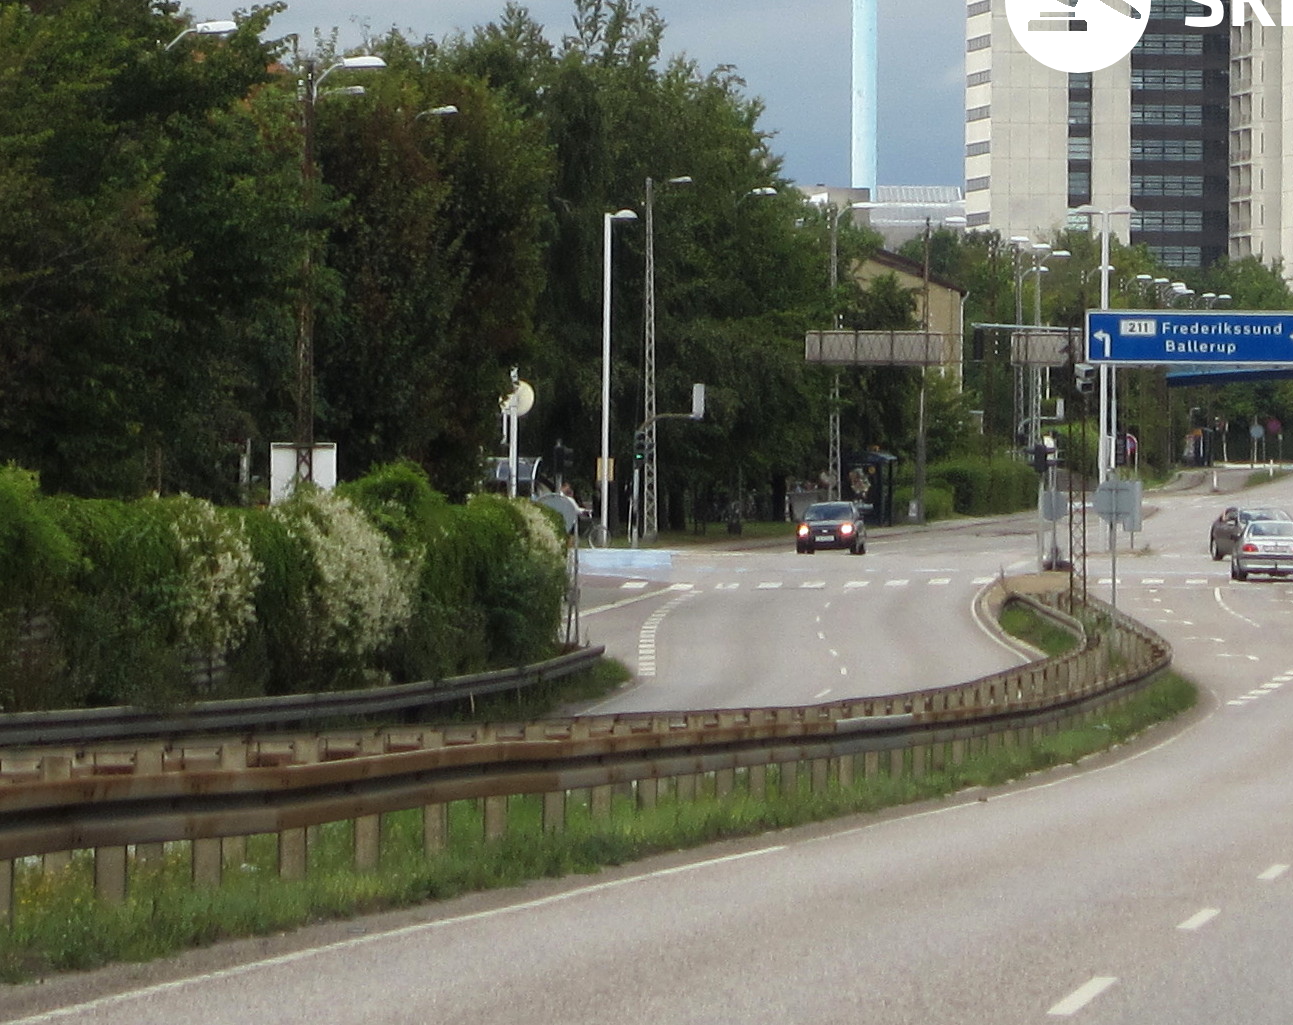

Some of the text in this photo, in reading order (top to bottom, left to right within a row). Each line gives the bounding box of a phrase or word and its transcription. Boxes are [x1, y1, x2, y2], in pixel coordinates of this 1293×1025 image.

[1127, 322, 1283, 335] 211 Frederikssund
[1165, 340, 1236, 354] Ballerup
